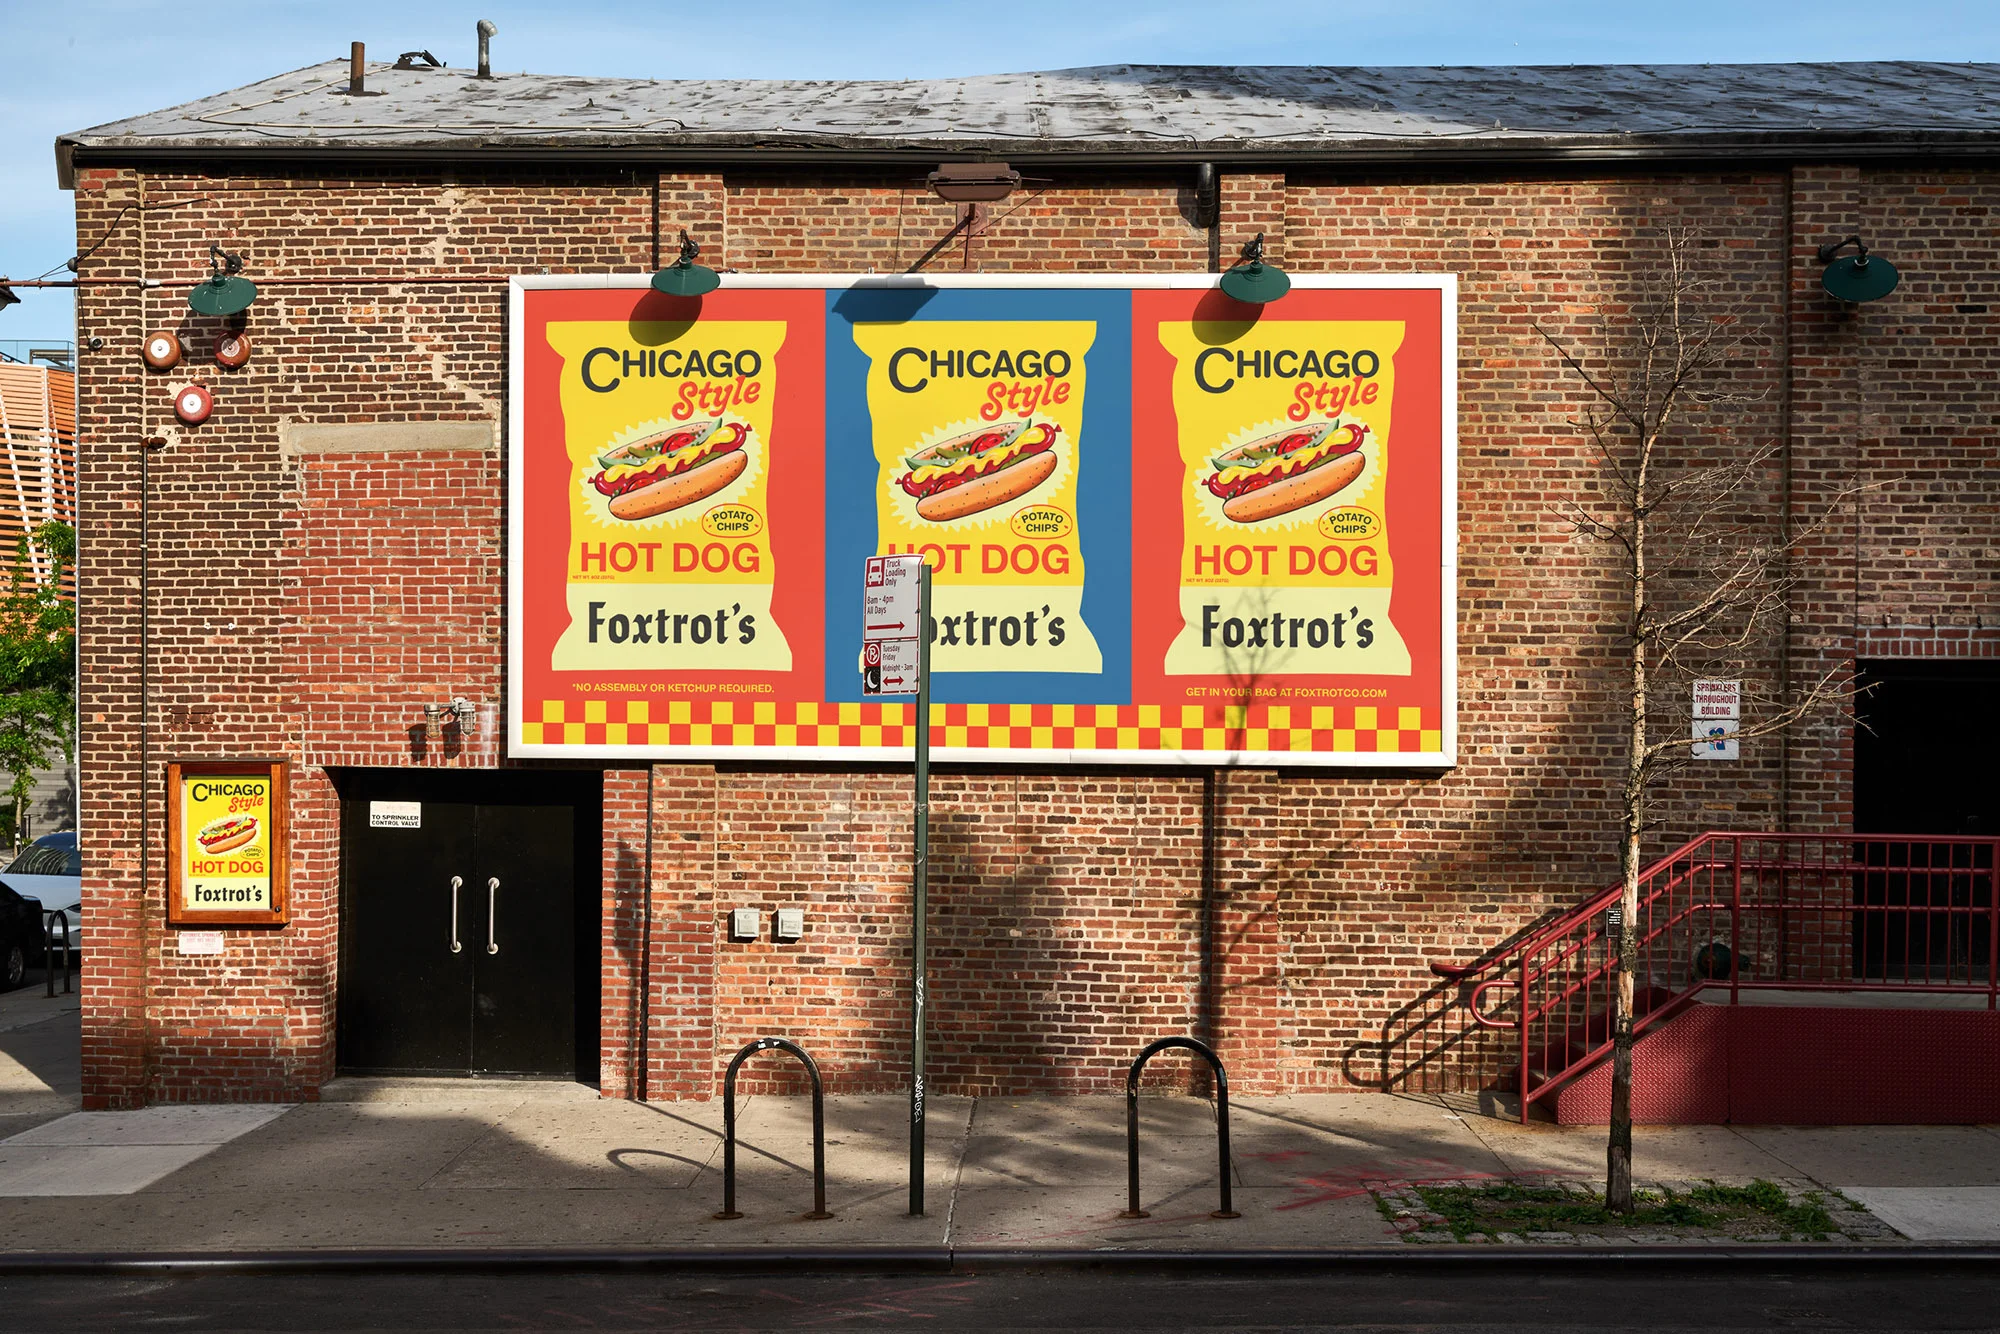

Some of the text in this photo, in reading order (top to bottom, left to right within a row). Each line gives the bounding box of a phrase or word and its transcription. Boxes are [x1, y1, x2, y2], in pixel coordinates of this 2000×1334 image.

[581, 347, 762, 393] CHICAGO
[888, 347, 1072, 394] CHICAGO
[1194, 347, 1380, 394] CHICAGO
[671, 375, 761, 421] Style
[980, 375, 1071, 421] Style
[1287, 375, 1379, 422] Style
[712, 510, 754, 523] POTATO
[1021, 511, 1064, 524] POTATO
[1329, 512, 1372, 525] POTATO
[716, 522, 749, 531] CHIPS
[1025, 523, 1059, 533] CHIPS
[1333, 524, 1367, 534] CHIPS
[581, 542, 760, 573] HOT DOG
[886, 559, 901, 568] Truck
[981, 543, 1070, 575] DOG
[1194, 544, 1378, 576] HOT DOG
[885, 568, 906, 577] Loading
[885, 578, 897, 587] Only
[882, 595, 894, 604] 4pm
[874, 606, 887, 615] Days
[588, 601, 756, 645] Foxtrot's
[1202, 605, 1374, 649] Foxtrot's
[594, 683, 648, 692] ASSEMBLY
[650, 683, 665, 692] OR
[668, 684, 717, 693] KETCHUP
[719, 684, 775, 693] REQUIRED.
[1185, 687, 1387, 698] GET IN YOUR BAG AT FOXTROTCO.COM
[1696, 683, 1736, 692] SPRINKLERS
[1695, 694, 1737, 704] THROUGHOUT
[1701, 706, 1731, 715] BUILDING
[192, 783, 265, 802] CHICAGO
[228, 794, 264, 813] Style
[192, 860, 264, 873] HOT DOG
[195, 884, 262, 902] Foxtrot's
